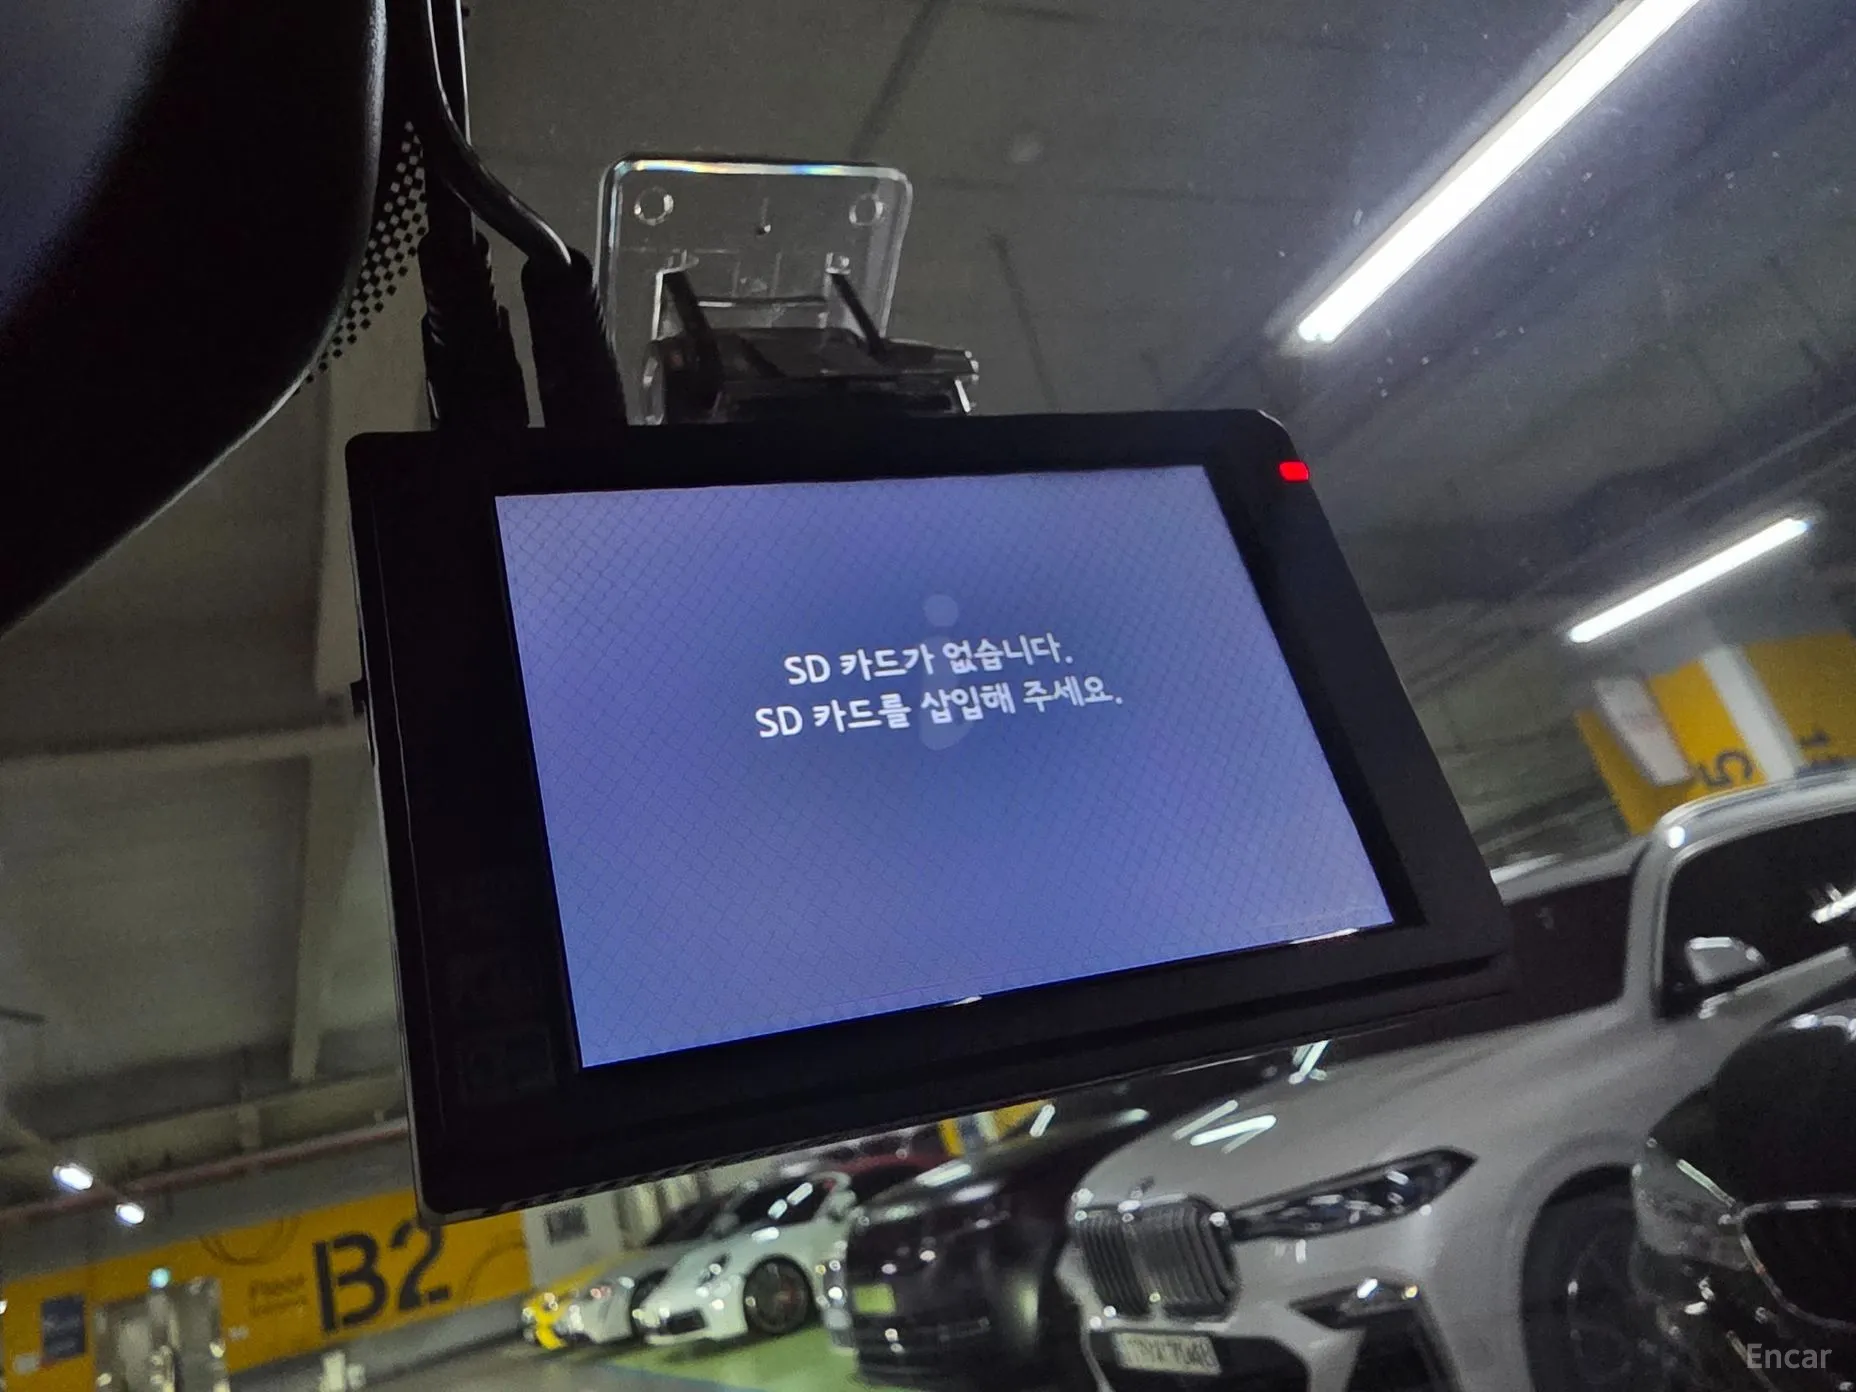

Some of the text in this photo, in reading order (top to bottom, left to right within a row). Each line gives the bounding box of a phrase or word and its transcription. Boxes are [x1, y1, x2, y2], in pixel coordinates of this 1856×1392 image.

[784, 632, 1073, 685] SD 카드가 없습니다.
[755, 675, 1123, 738] SD 카드를 삽입해 주세요.
[313, 1219, 452, 1332] B2
